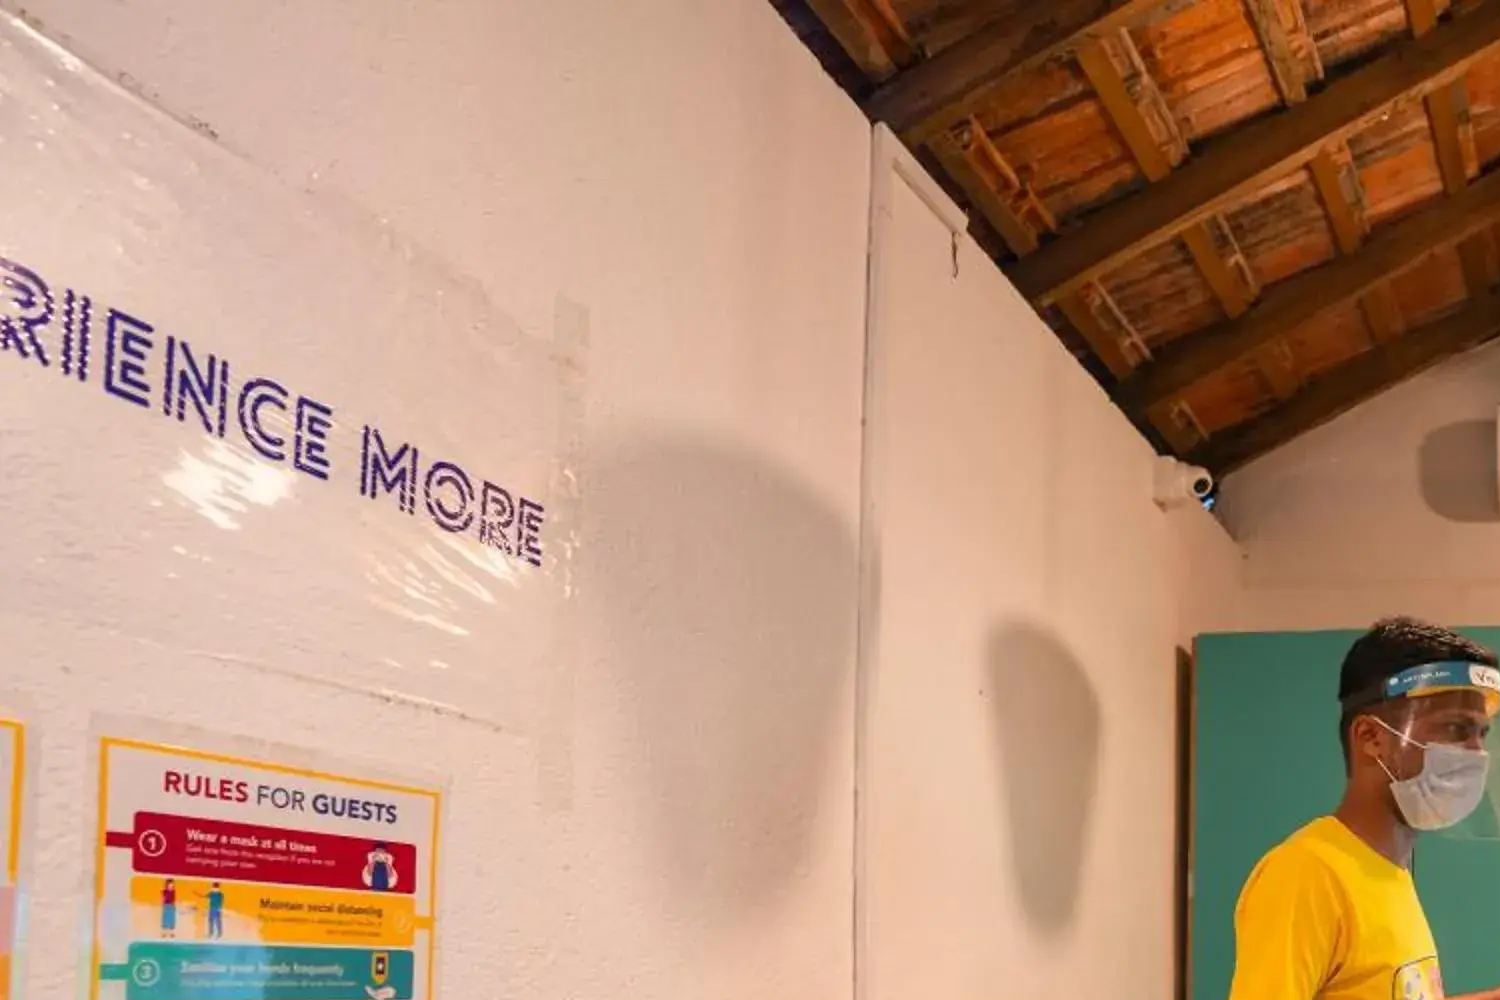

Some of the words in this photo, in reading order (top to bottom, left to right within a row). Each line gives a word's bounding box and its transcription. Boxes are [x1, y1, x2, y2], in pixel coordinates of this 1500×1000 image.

[359, 424, 544, 567] MORE
[164, 771, 249, 803] RULES
[257, 785, 305, 811] FOR
[313, 793, 398, 824] GUESTS
[187, 829, 217, 842] Wear
[220, 836, 228, 844] a
[230, 836, 259, 847] mask
[261, 839, 272, 848] at
[274, 840, 287, 850] all
[289, 841, 317, 854] times
[259, 898, 303, 911] Maintain
[307, 903, 334, 913] social
